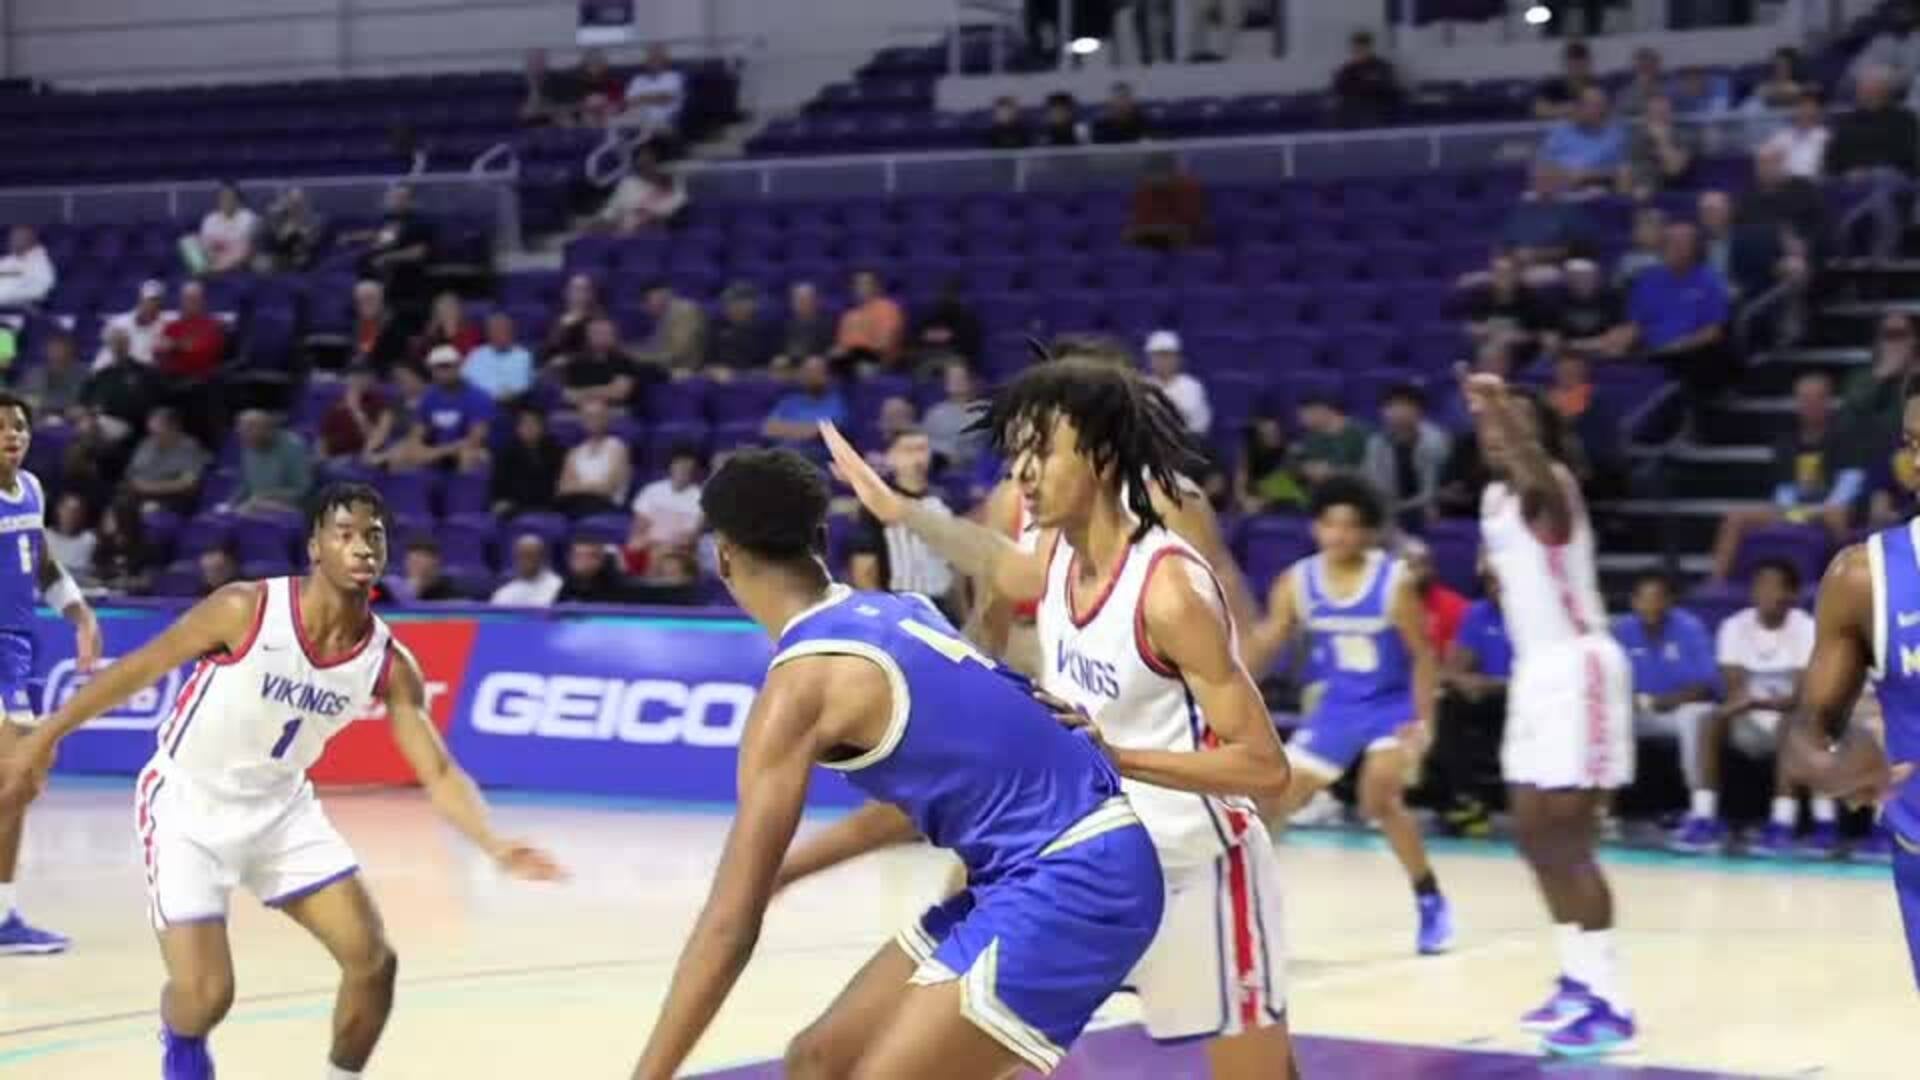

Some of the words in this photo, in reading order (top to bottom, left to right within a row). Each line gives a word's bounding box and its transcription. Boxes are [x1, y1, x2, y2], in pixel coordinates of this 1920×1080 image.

[261, 672, 351, 717] VIKINGS
[471, 671, 757, 747] GEICO
[270, 716, 304, 760] 1
